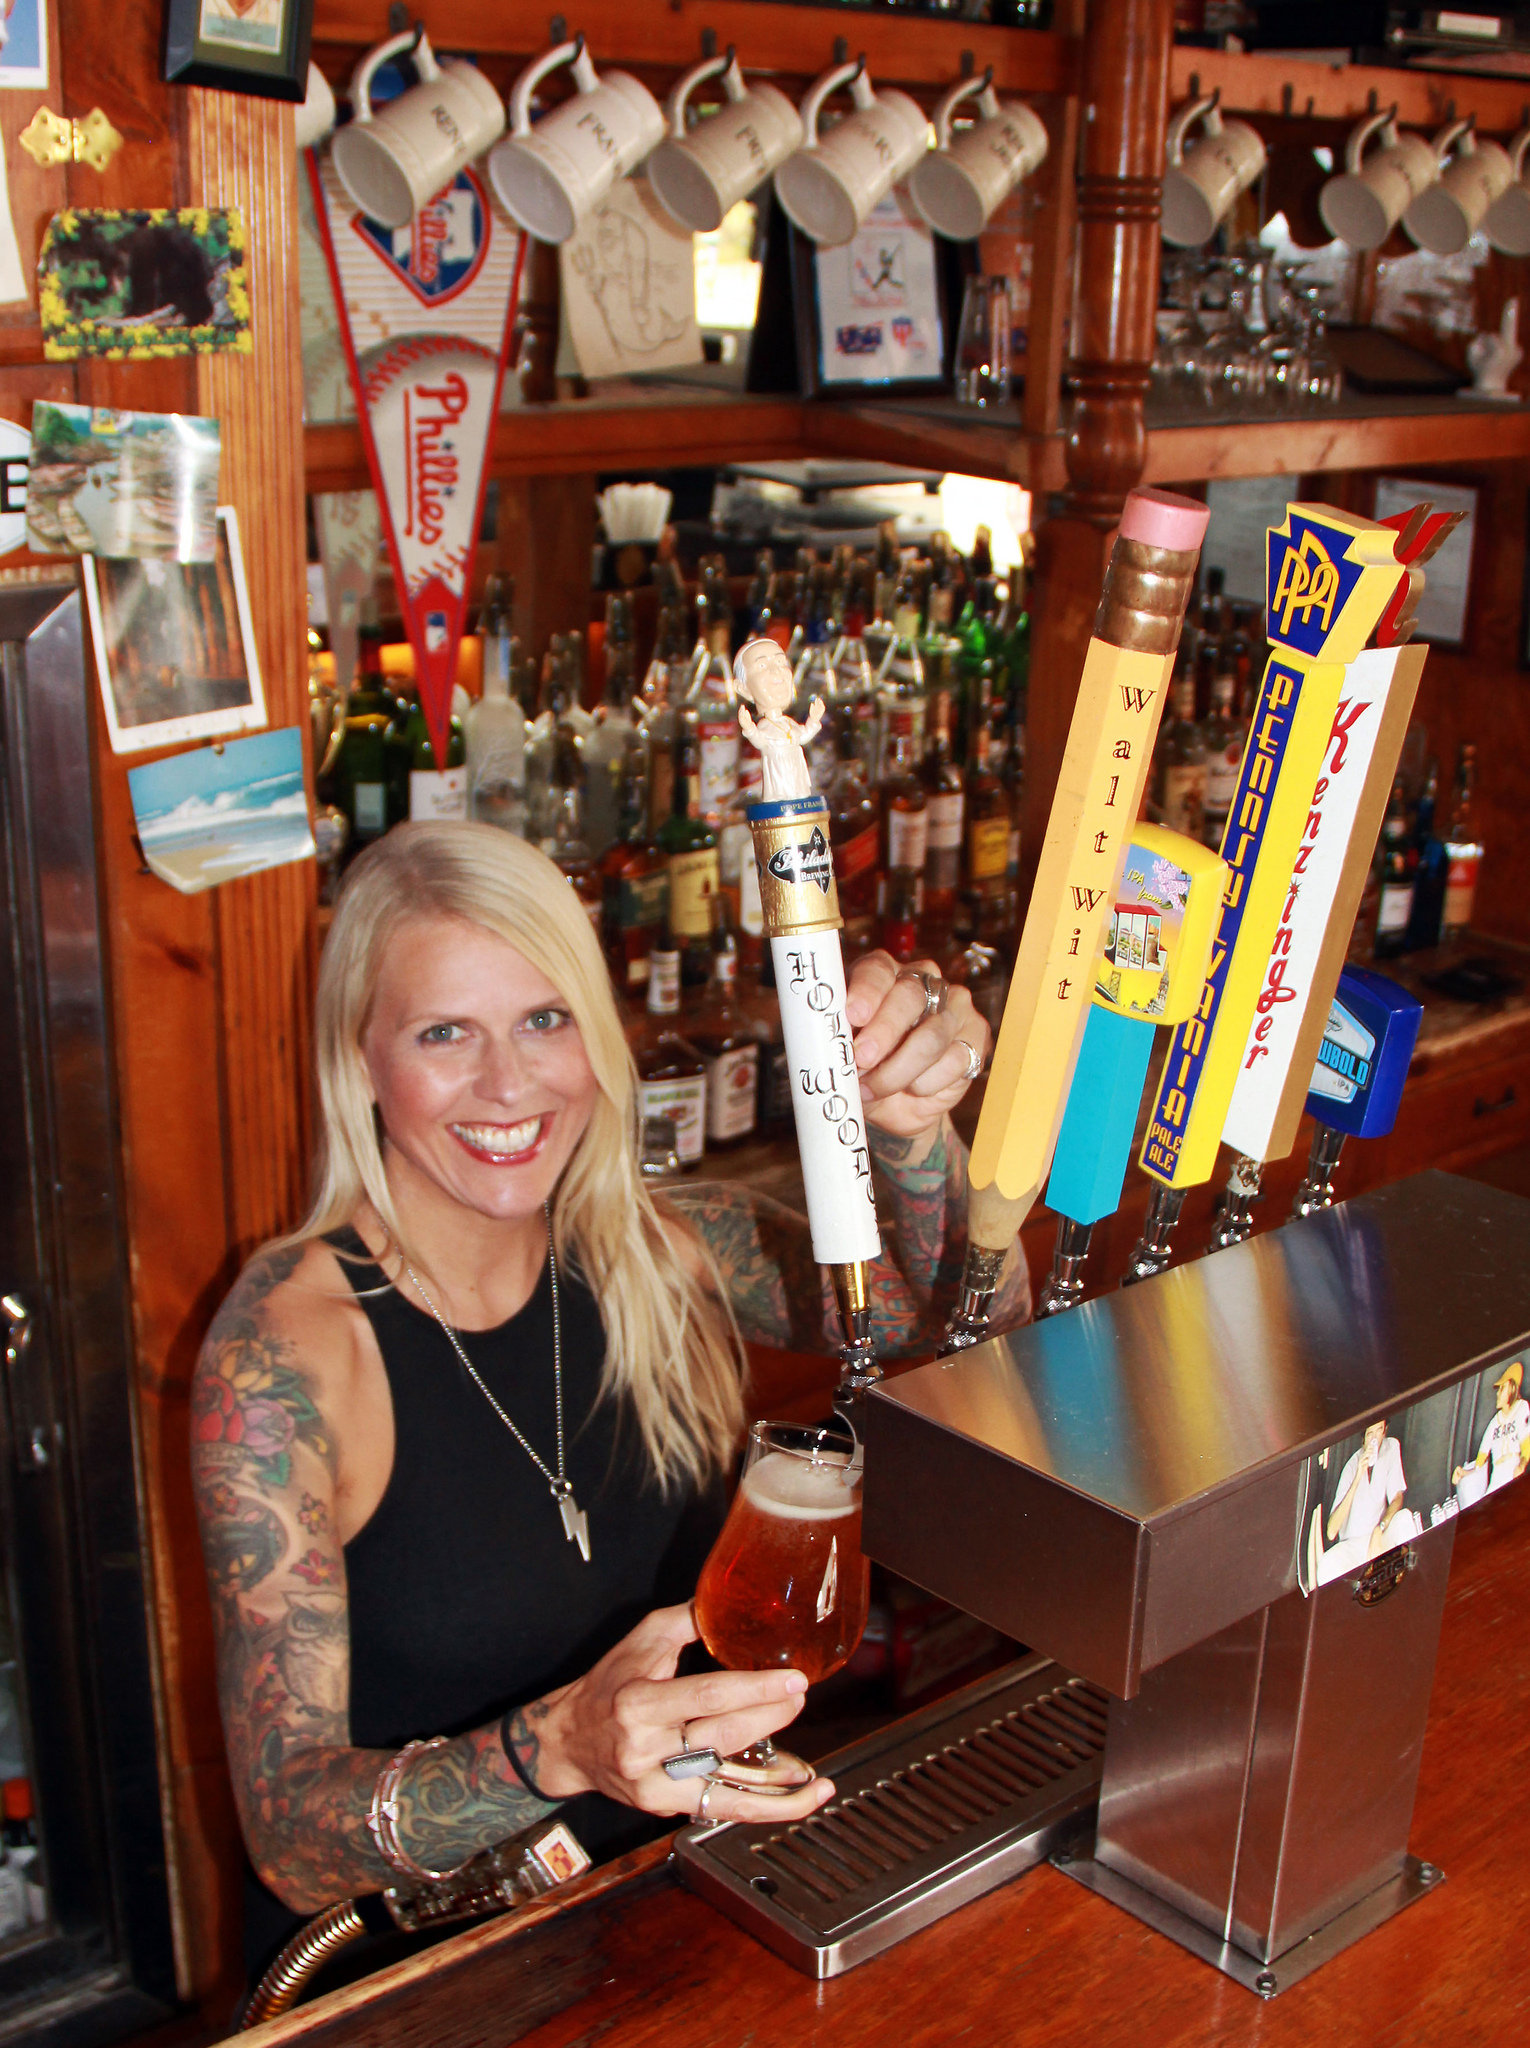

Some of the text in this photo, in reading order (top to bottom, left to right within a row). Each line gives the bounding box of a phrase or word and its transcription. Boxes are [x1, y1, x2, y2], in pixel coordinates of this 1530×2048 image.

[413, 371, 470, 546] Phillies
[1056, 684, 1160, 1001] Walt Wit
[1126, 867, 1146, 887] IPA
[1137, 886, 1164, 908] from
[1160, 673, 1294, 1128] PENNSYLVANIA
[1244, 696, 1373, 1070] Kenzinger
[786, 950, 856, 1077] HOLY
[1148, 1142, 1175, 1173] ALE
[1150, 1122, 1183, 1155] PALE
